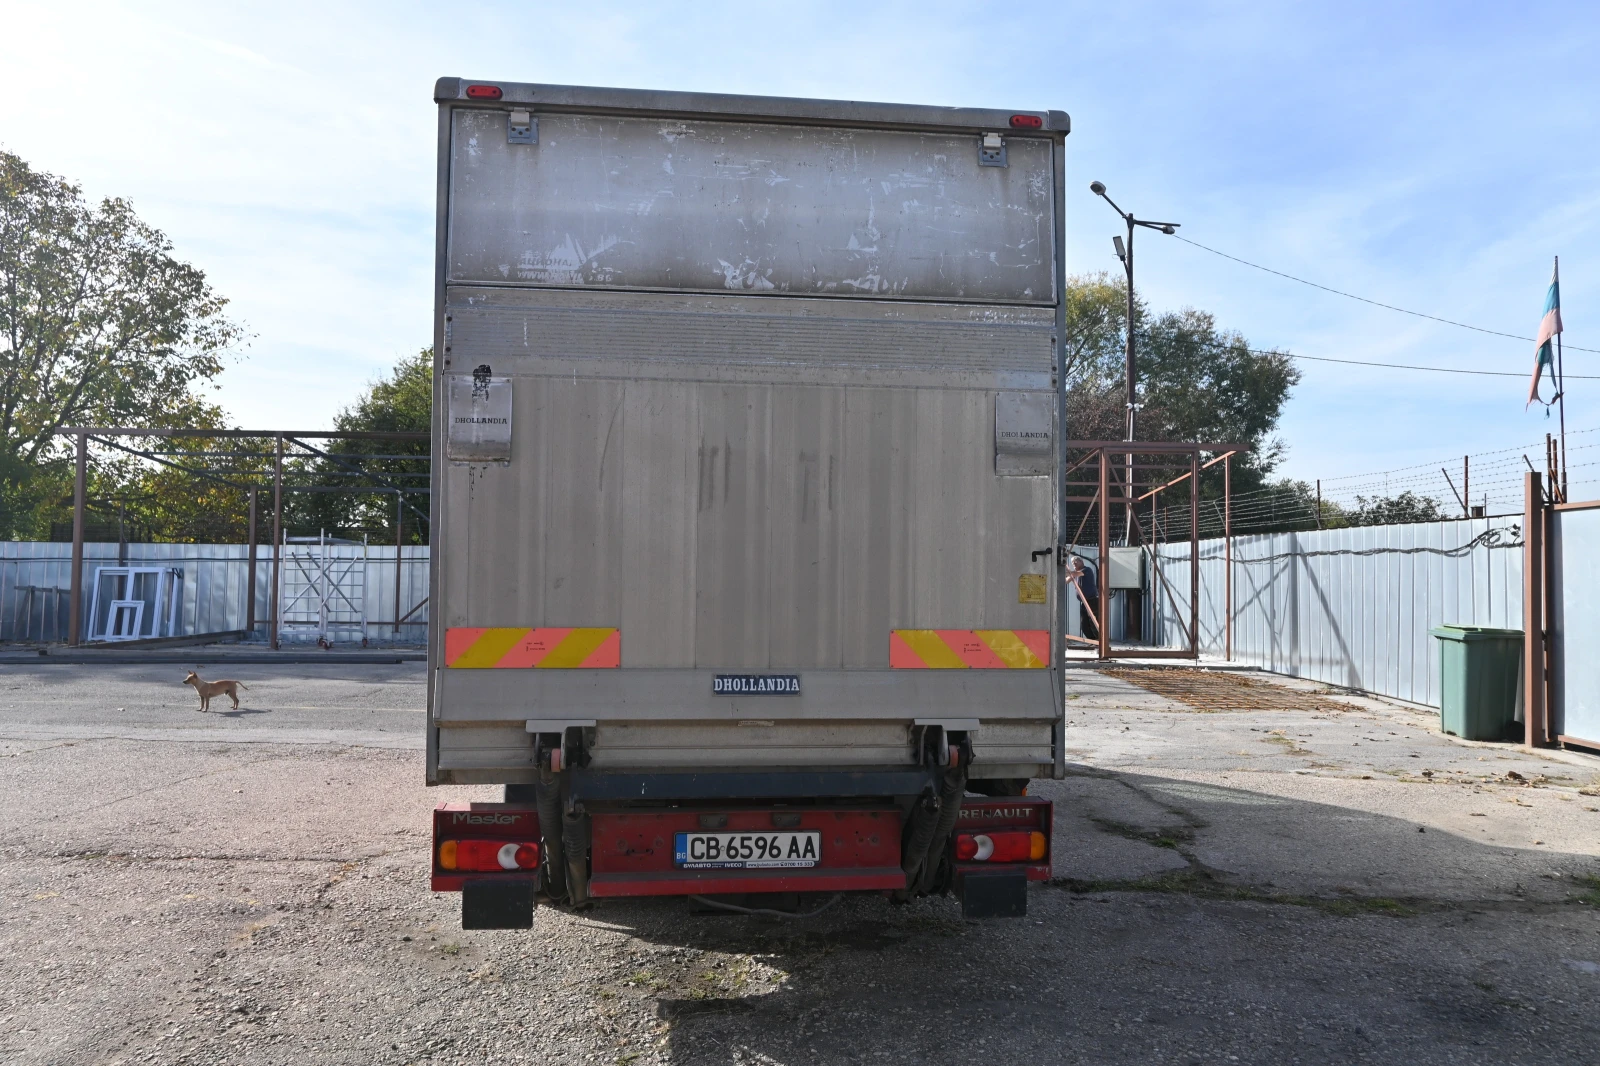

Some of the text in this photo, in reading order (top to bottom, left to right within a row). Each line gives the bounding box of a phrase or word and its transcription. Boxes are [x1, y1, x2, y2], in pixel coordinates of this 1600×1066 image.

[455, 417, 508, 425] DHOLLANDIA
[714, 678, 800, 692] DHOLLANDIA
[452, 812, 522, 825] Master
[958, 808, 1033, 819] RENAULT
[725, 836, 782, 860] 6596
[786, 835, 817, 859] AA
[676, 852, 687, 860] BG
